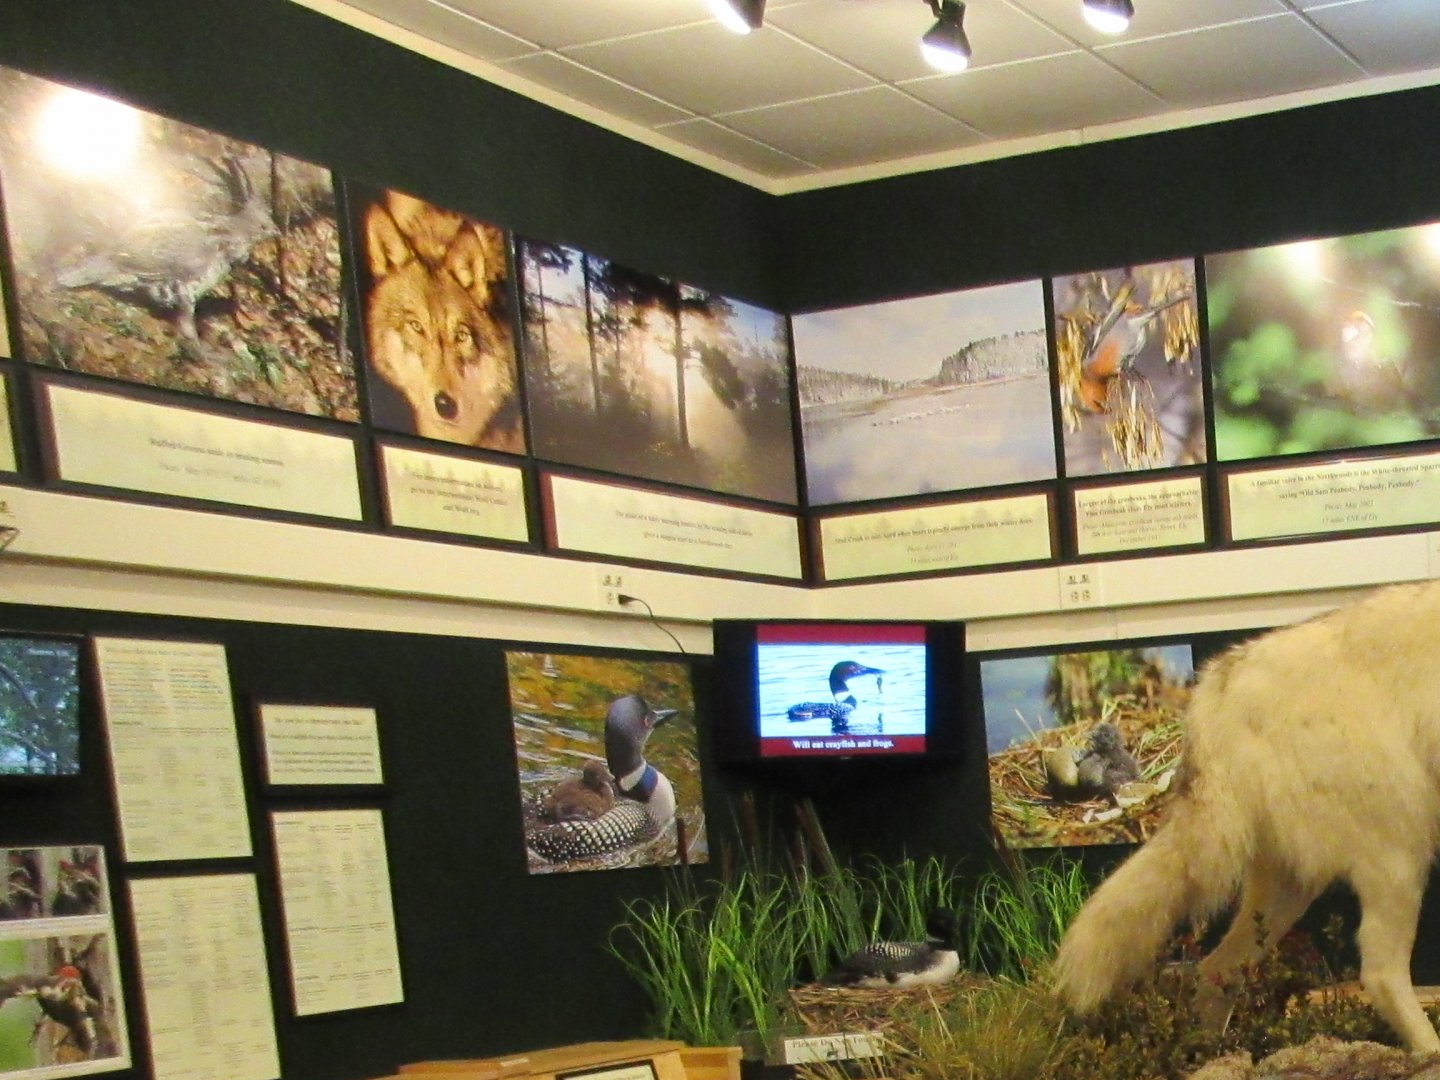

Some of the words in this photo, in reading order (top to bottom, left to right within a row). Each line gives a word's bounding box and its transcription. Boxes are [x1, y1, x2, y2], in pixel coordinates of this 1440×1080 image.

[793, 740, 810, 748] Will
[825, 740, 856, 750] crayfish
[858, 740, 871, 748] and
[873, 739, 894, 748] frogs.
